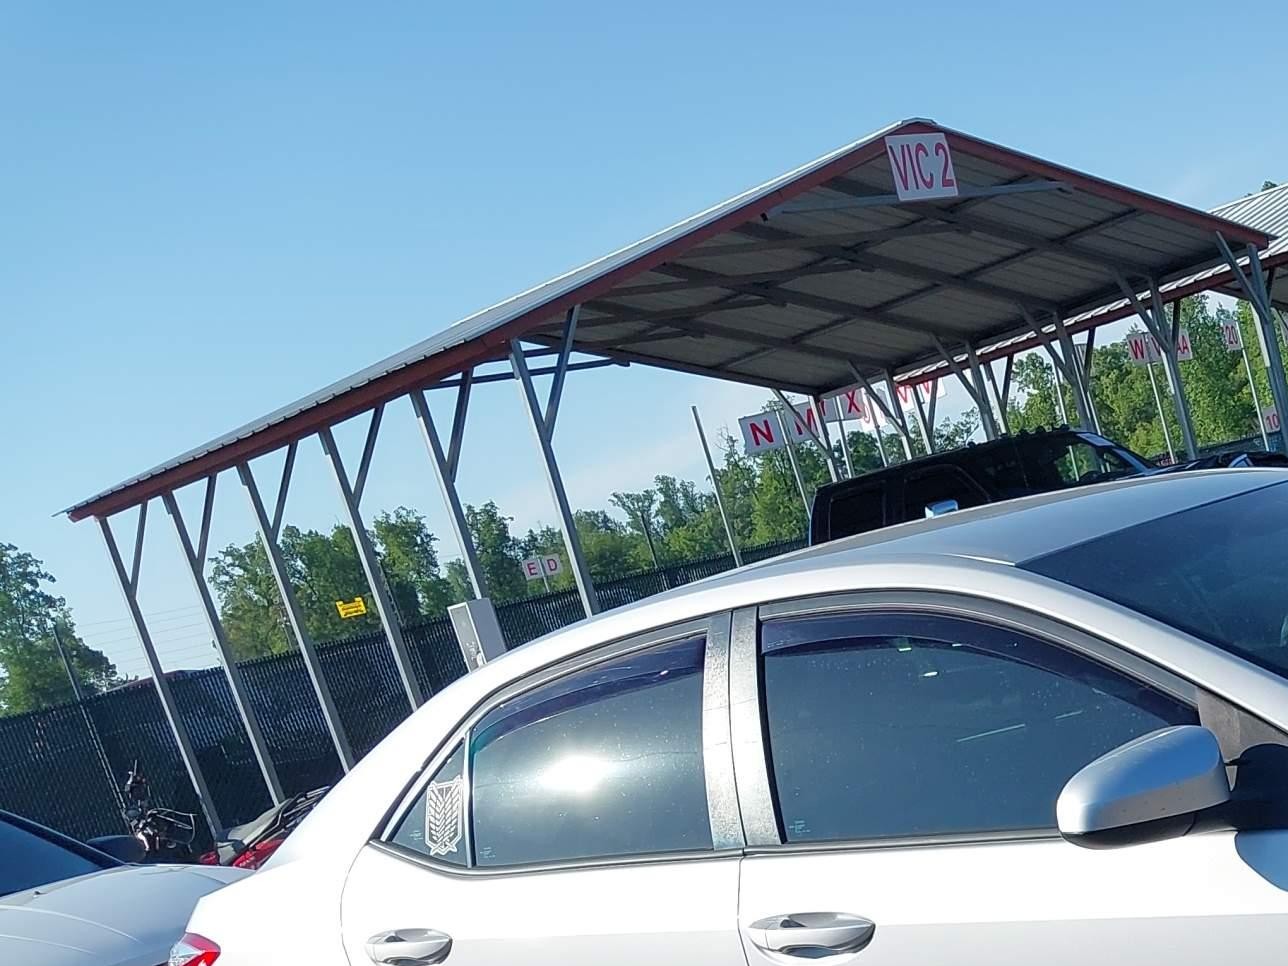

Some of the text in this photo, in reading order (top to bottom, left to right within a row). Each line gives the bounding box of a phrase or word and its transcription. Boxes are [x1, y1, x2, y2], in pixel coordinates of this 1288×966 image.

[888, 142, 955, 191] VIC 2
[1225, 325, 1239, 345] 20
[1128, 339, 1146, 360] W
[846, 389, 861, 414] X
[749, 419, 775, 446] N
[526, 562, 539, 576] E
[546, 558, 558, 572] D
